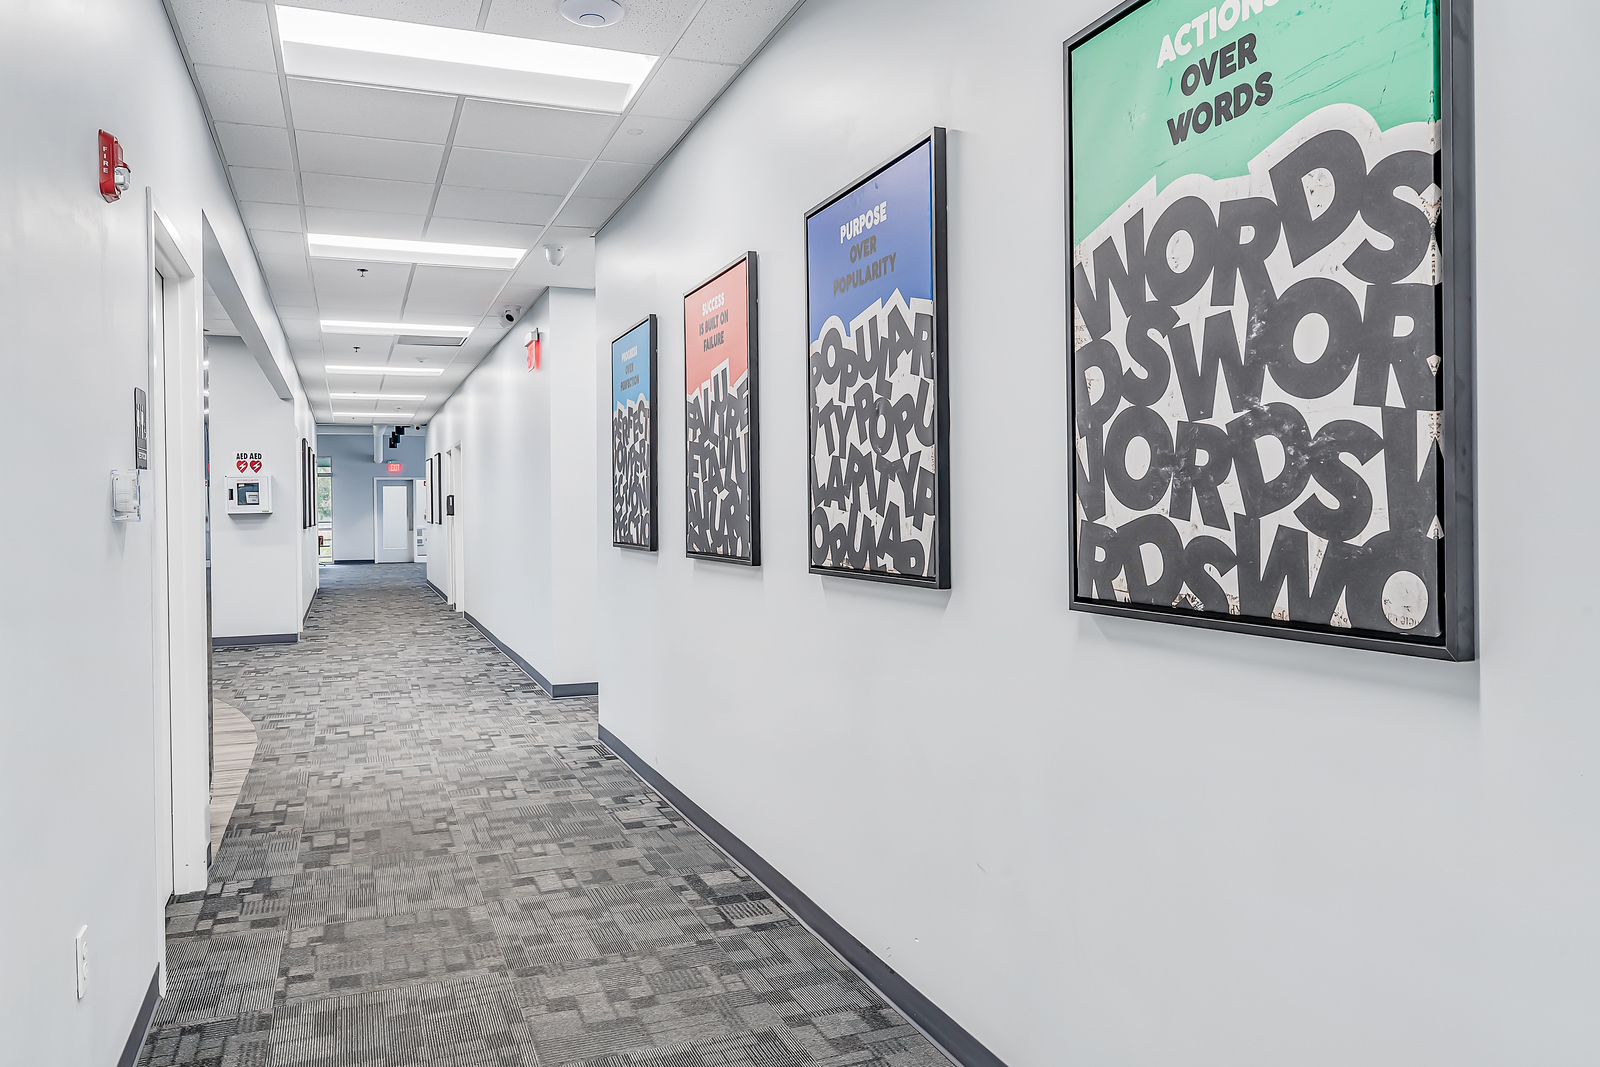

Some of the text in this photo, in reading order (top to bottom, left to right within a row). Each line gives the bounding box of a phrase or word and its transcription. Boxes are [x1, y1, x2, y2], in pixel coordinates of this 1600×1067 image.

[1156, 0, 1280, 69] ACTION
[1180, 32, 1258, 97] OVER
[1167, 71, 1274, 146] WORDS
[840, 201, 887, 244] PURPOSE
[1075, 129, 1440, 345] WORDS
[850, 235, 877, 264] OVER
[833, 252, 897, 297] POPULARITY
[702, 292, 725, 316] SUCCESS
[699, 309, 729, 337] IS BUILT ON
[703, 330, 725, 352] FAILURE
[620, 374, 640, 392] PERFECTION
[625, 361, 634, 375] OVER
